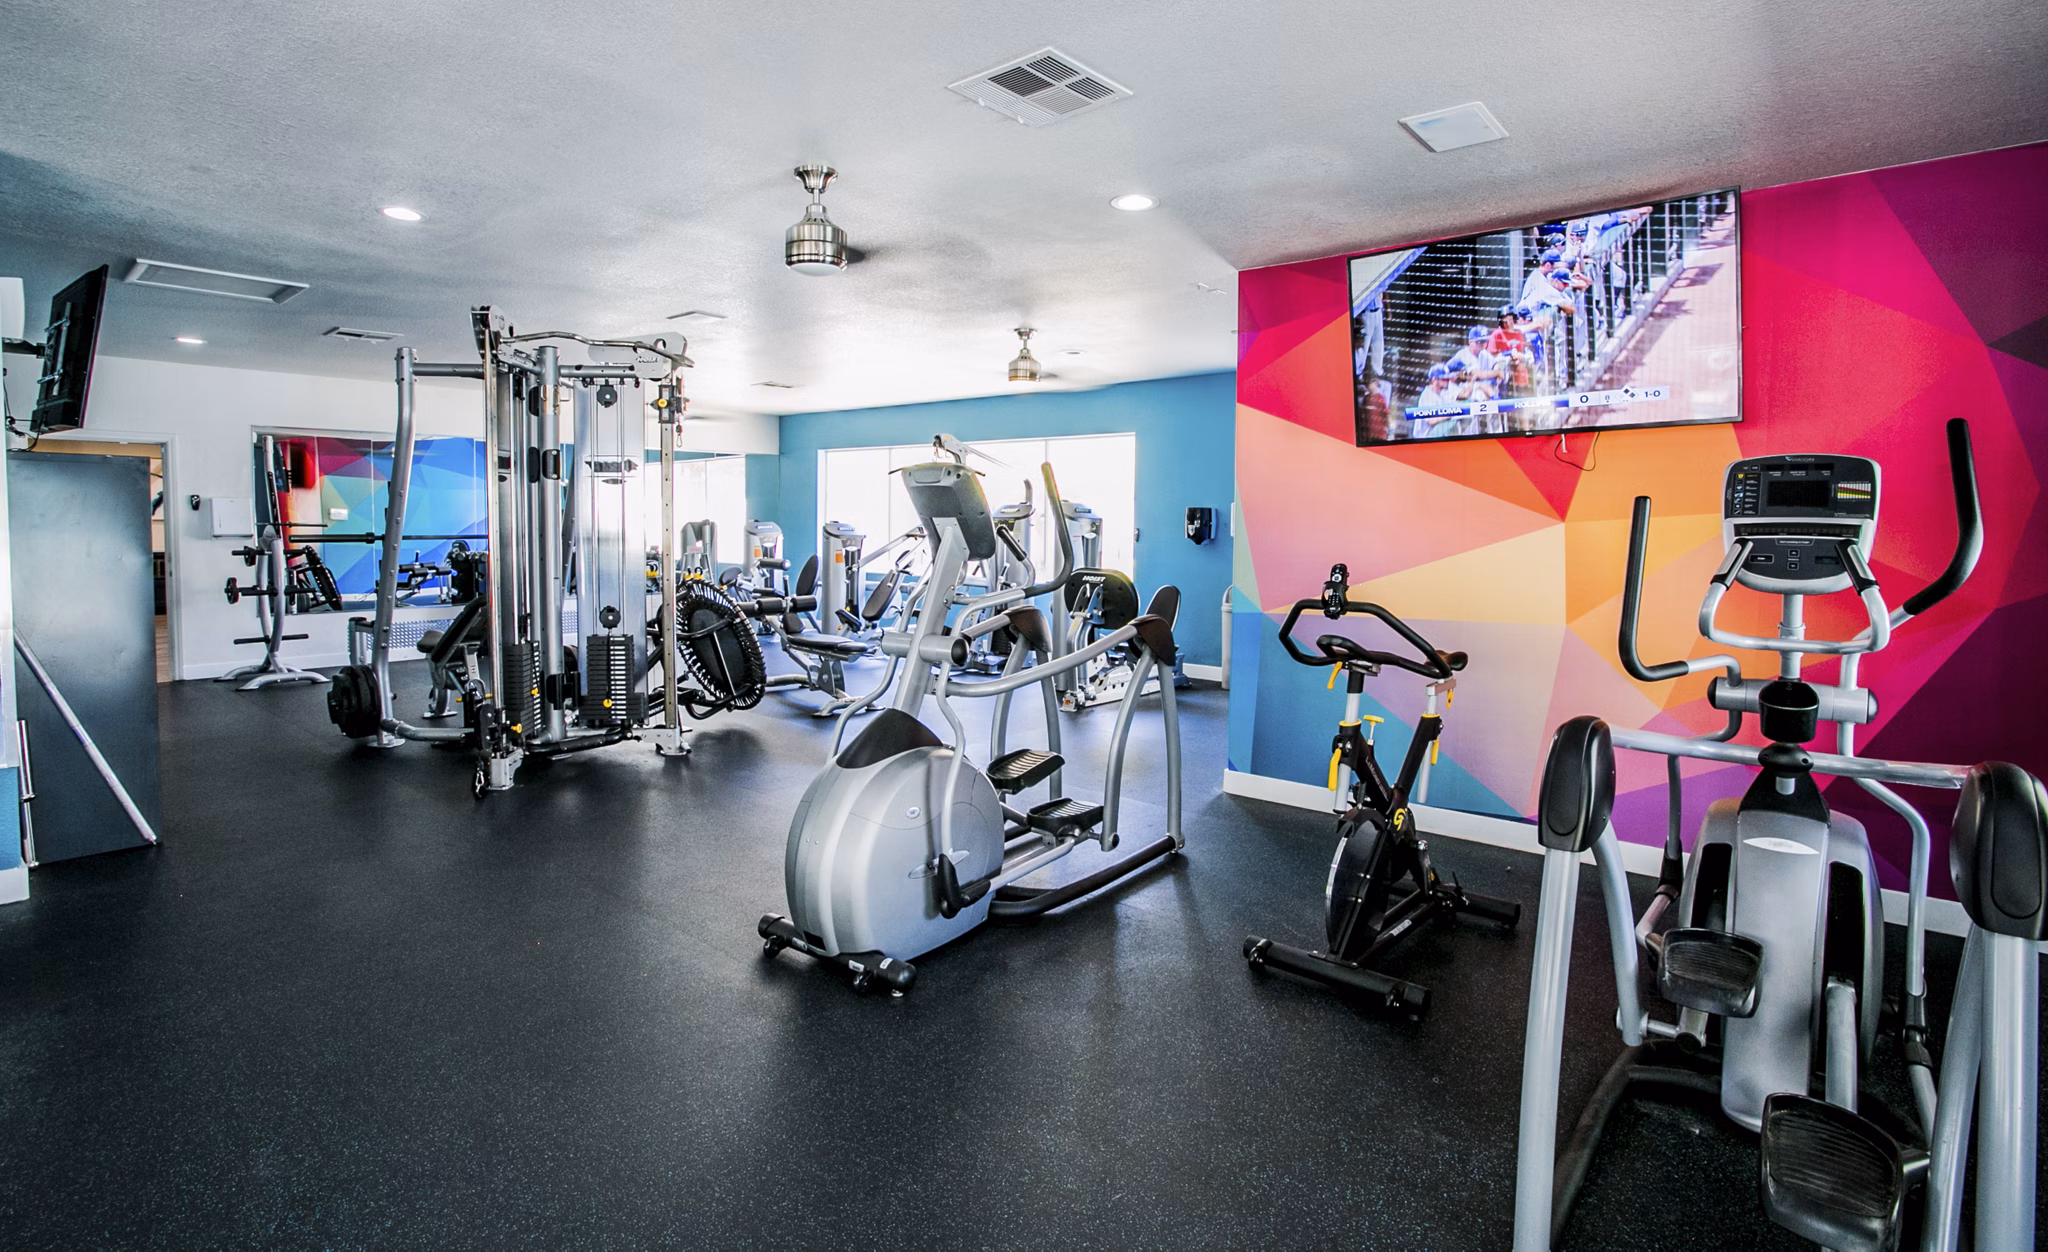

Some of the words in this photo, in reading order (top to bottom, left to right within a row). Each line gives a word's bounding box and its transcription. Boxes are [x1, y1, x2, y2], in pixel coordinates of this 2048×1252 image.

[1414, 409, 1437, 417] POINT
[1438, 407, 1462, 415] LOMA
[1480, 404, 1487, 412] 2
[1580, 394, 1589, 403] 0
[1645, 390, 1661, 398] 1-0
